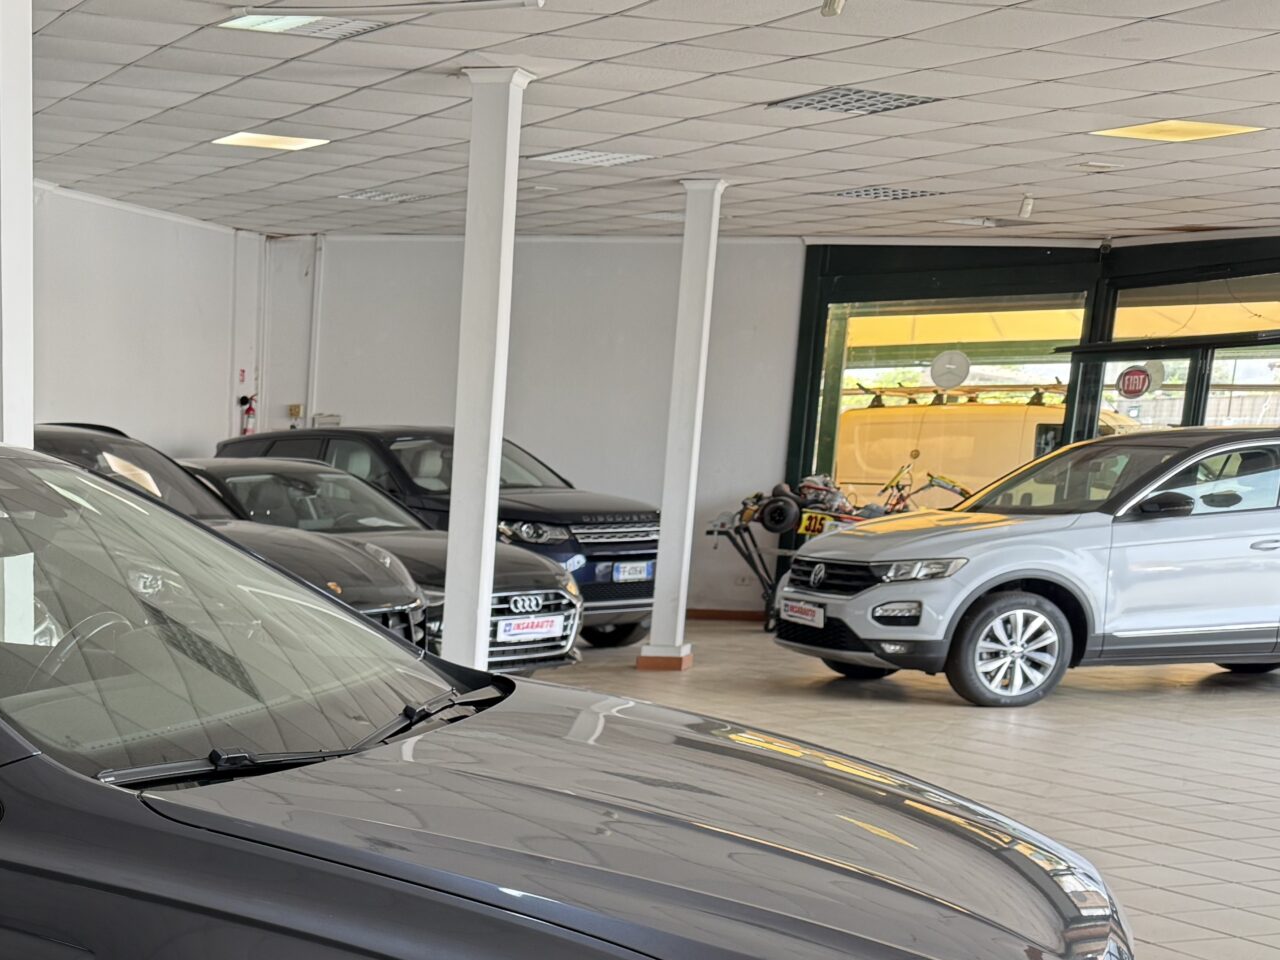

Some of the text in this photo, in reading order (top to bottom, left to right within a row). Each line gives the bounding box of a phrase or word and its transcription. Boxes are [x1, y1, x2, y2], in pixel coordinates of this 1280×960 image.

[1124, 375, 1145, 391] FIAT
[582, 514, 653, 522] DISCOVERY
[805, 515, 826, 534] 315
